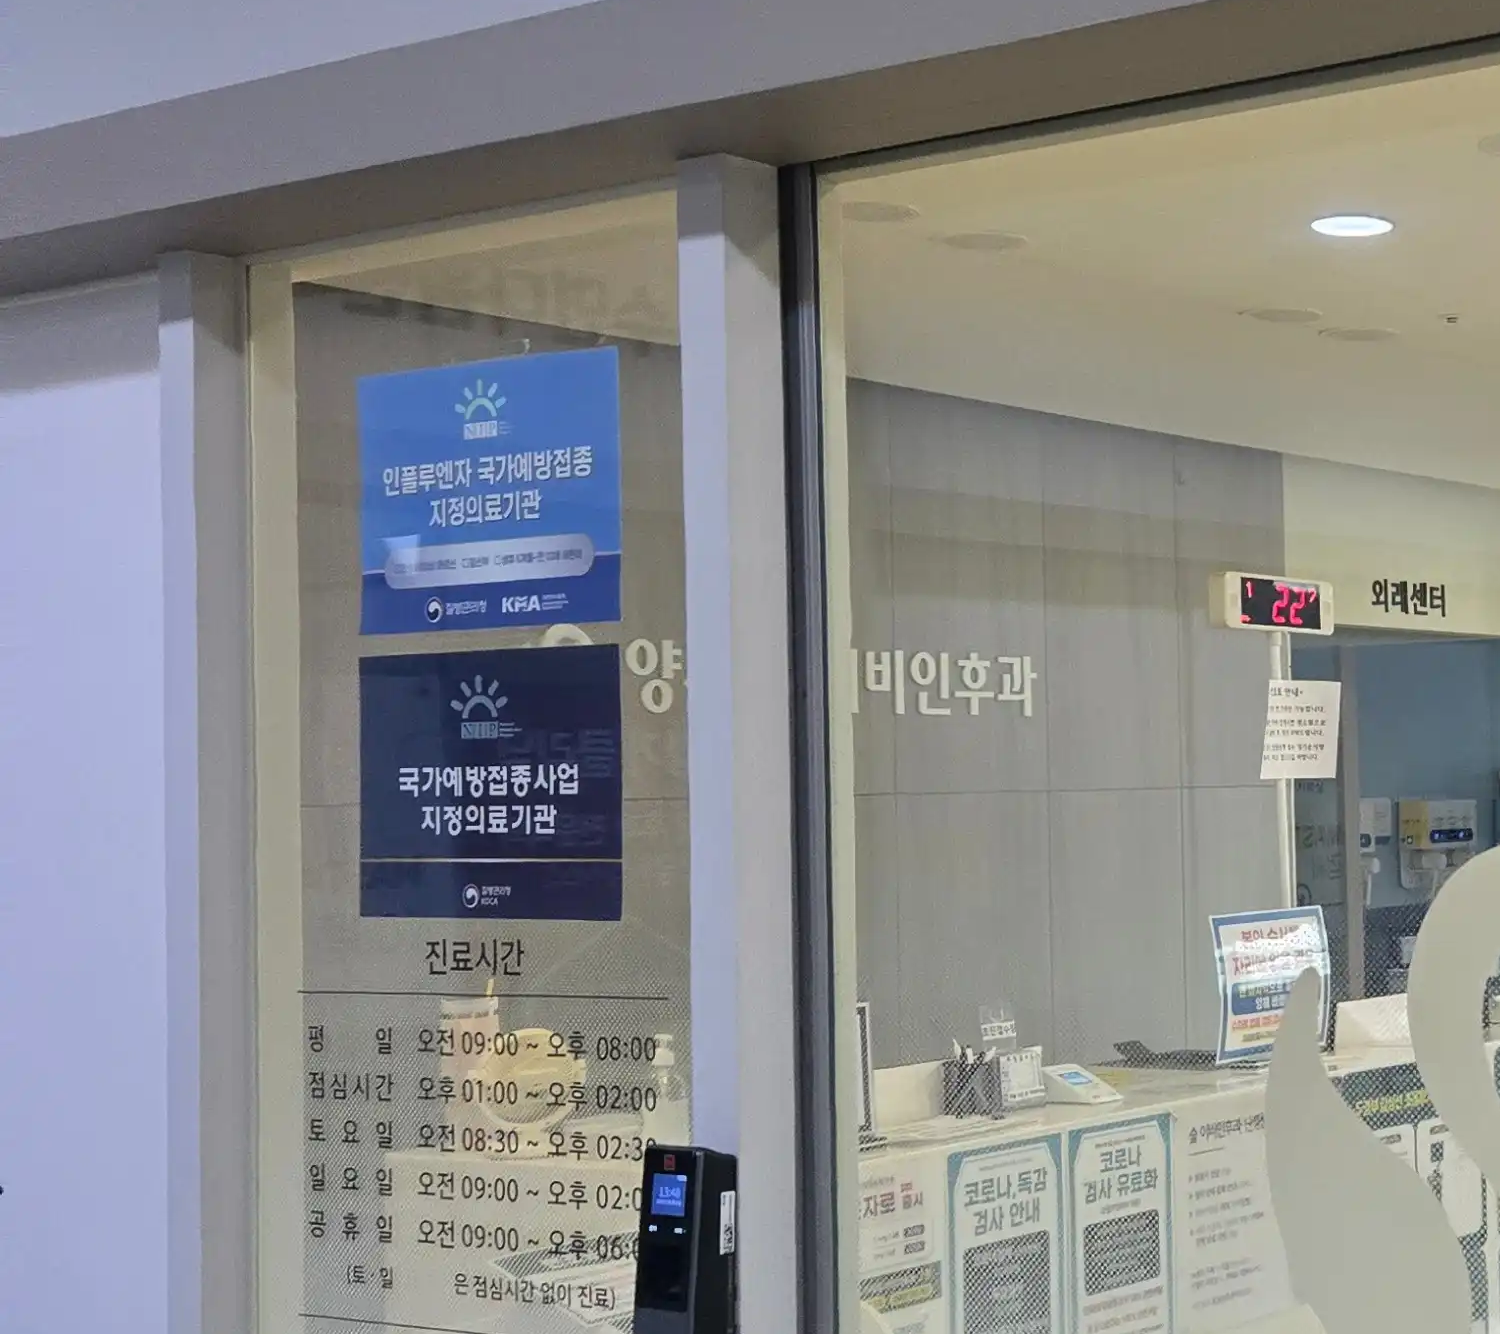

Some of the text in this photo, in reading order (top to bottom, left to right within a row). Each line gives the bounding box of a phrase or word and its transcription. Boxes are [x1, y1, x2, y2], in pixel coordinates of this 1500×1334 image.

[382, 446, 593, 496] 인플루엔자 국가예방접종
[429, 490, 543, 528] 지정의료기관
[1371, 578, 1447, 617] 외래센터
[625, 638, 686, 714] 양
[399, 763, 579, 797] 국가예방접종사업
[421, 805, 557, 835] 지정의료기관
[425, 939, 524, 976] 진료시간
[418, 1029, 455, 1057] 오전
[462, 1031, 519, 1057] 09:00
[547, 1032, 587, 1060] 오후
[596, 1036, 656, 1061] 08:00
[309, 1072, 394, 1102] 점심시간
[417, 1076, 456, 1104] 오후
[462, 1080, 519, 1105] 01:00
[547, 1081, 588, 1109] 오후
[595, 1085, 657, 1112] 02:00
[416, 1123, 456, 1151] 오전
[462, 1128, 519, 1154] 08:30
[547, 1131, 588, 1160] 오후
[1099, 1144, 1142, 1174] 코로나
[417, 1172, 455, 1200] 오전
[462, 1175, 519, 1203] 09:00
[547, 1181, 588, 1209] 오후
[1084, 1168, 1159, 1206] 검사 유료화
[973, 1197, 1040, 1237] 검사 안내
[417, 1219, 455, 1249] 오전
[462, 1224, 519, 1251] 09:00
[548, 1230, 588, 1259] 오후
[473, 1273, 536, 1304] 점심시간
[539, 1282, 572, 1309] 없이
[577, 1284, 617, 1311] 진료)
